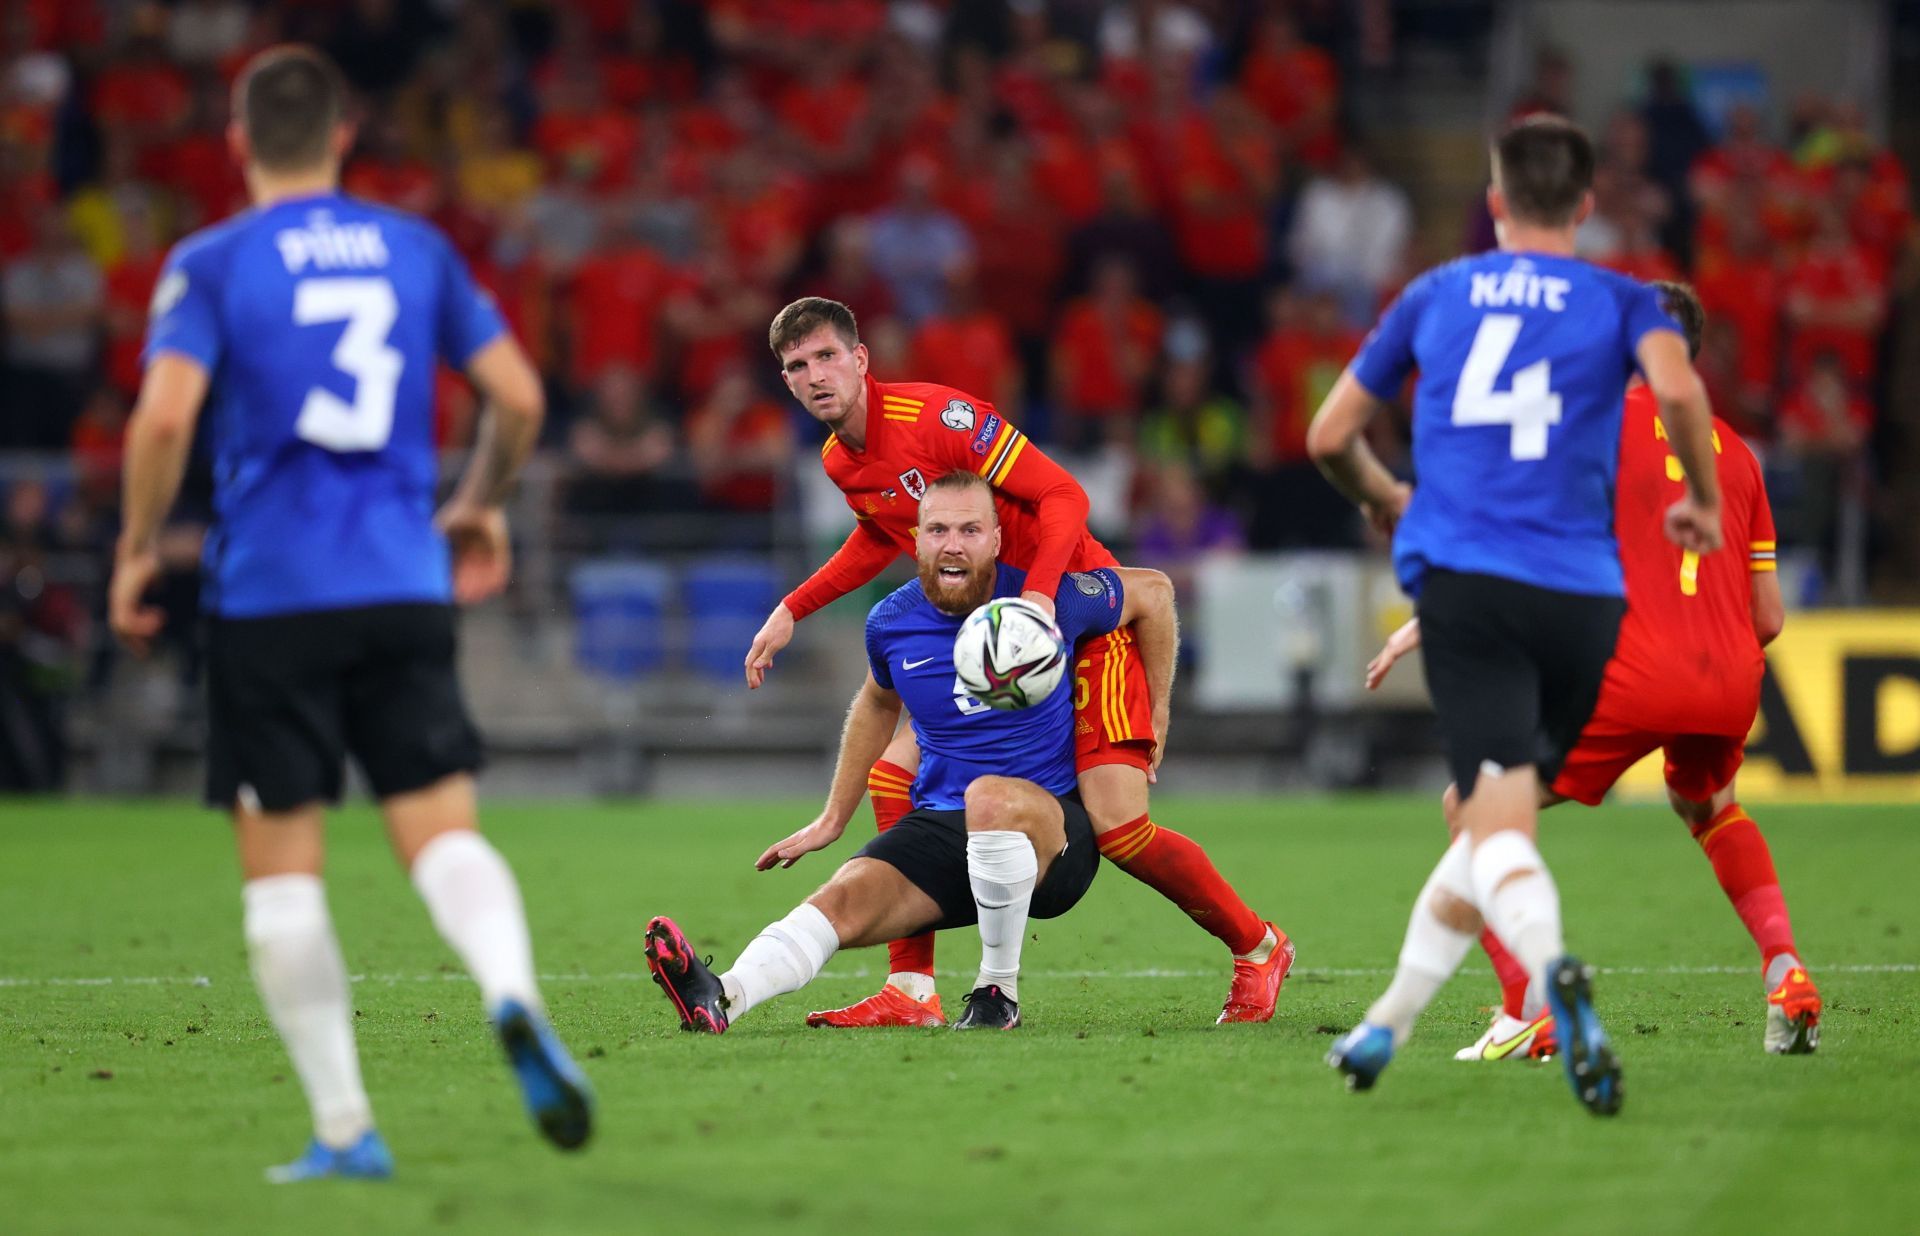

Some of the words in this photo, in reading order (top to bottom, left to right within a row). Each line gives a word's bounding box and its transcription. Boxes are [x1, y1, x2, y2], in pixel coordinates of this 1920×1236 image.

[294, 280, 404, 451] 3
[981, 414, 998, 442] RESPECT
[1452, 314, 1562, 461] 4
